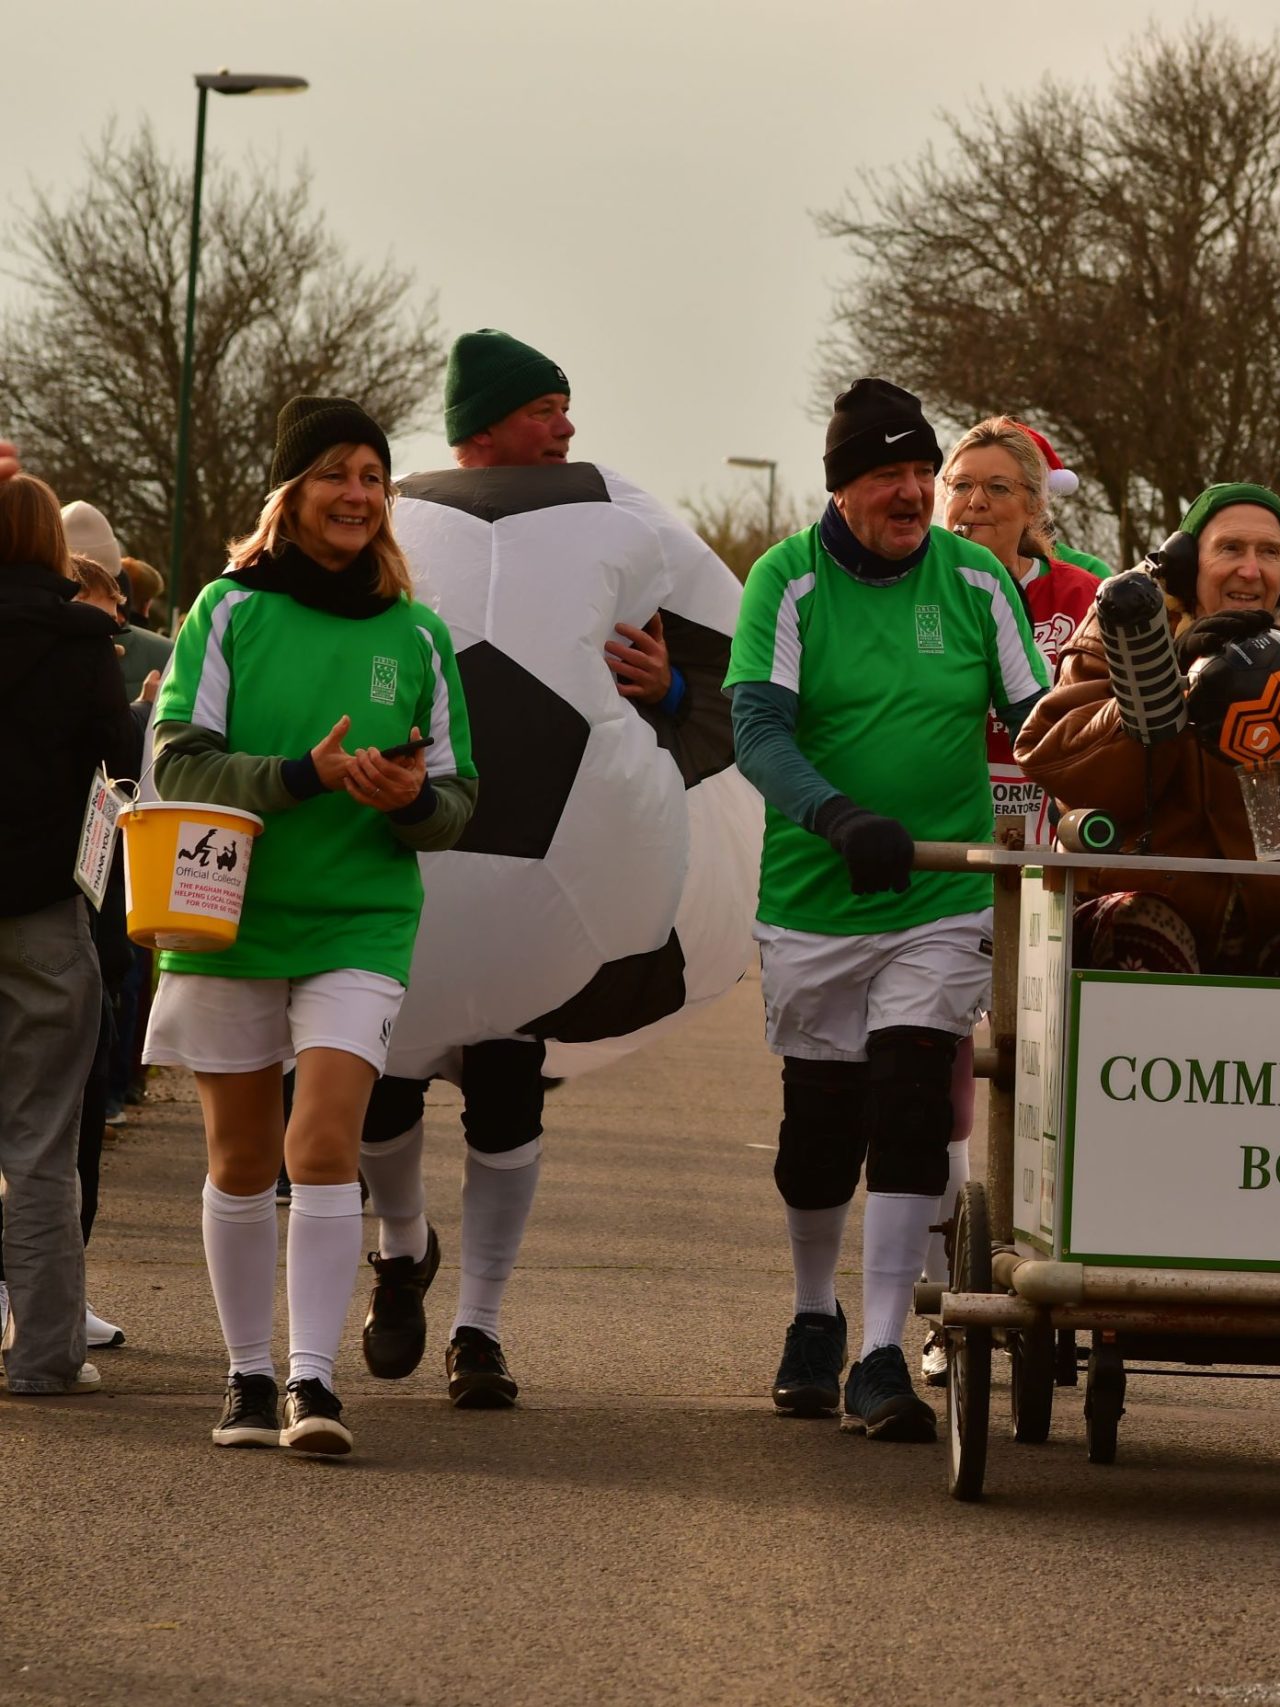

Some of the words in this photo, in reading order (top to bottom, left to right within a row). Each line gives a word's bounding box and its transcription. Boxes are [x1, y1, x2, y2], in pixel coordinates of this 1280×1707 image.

[993, 783, 1043, 802] ORNE
[992, 803, 1041, 815] ERATORS
[93, 854, 106, 890] THANK
[102, 827, 111, 850] YOU
[176, 866, 209, 879] Official
[180, 882, 193, 890] THE
[194, 883, 222, 894] PAGHAM
[175, 890, 205, 900] HELPING
[207, 893, 225, 903] LOCAL
[186, 899, 200, 907] FOR
[201, 901, 219, 910] OVER
